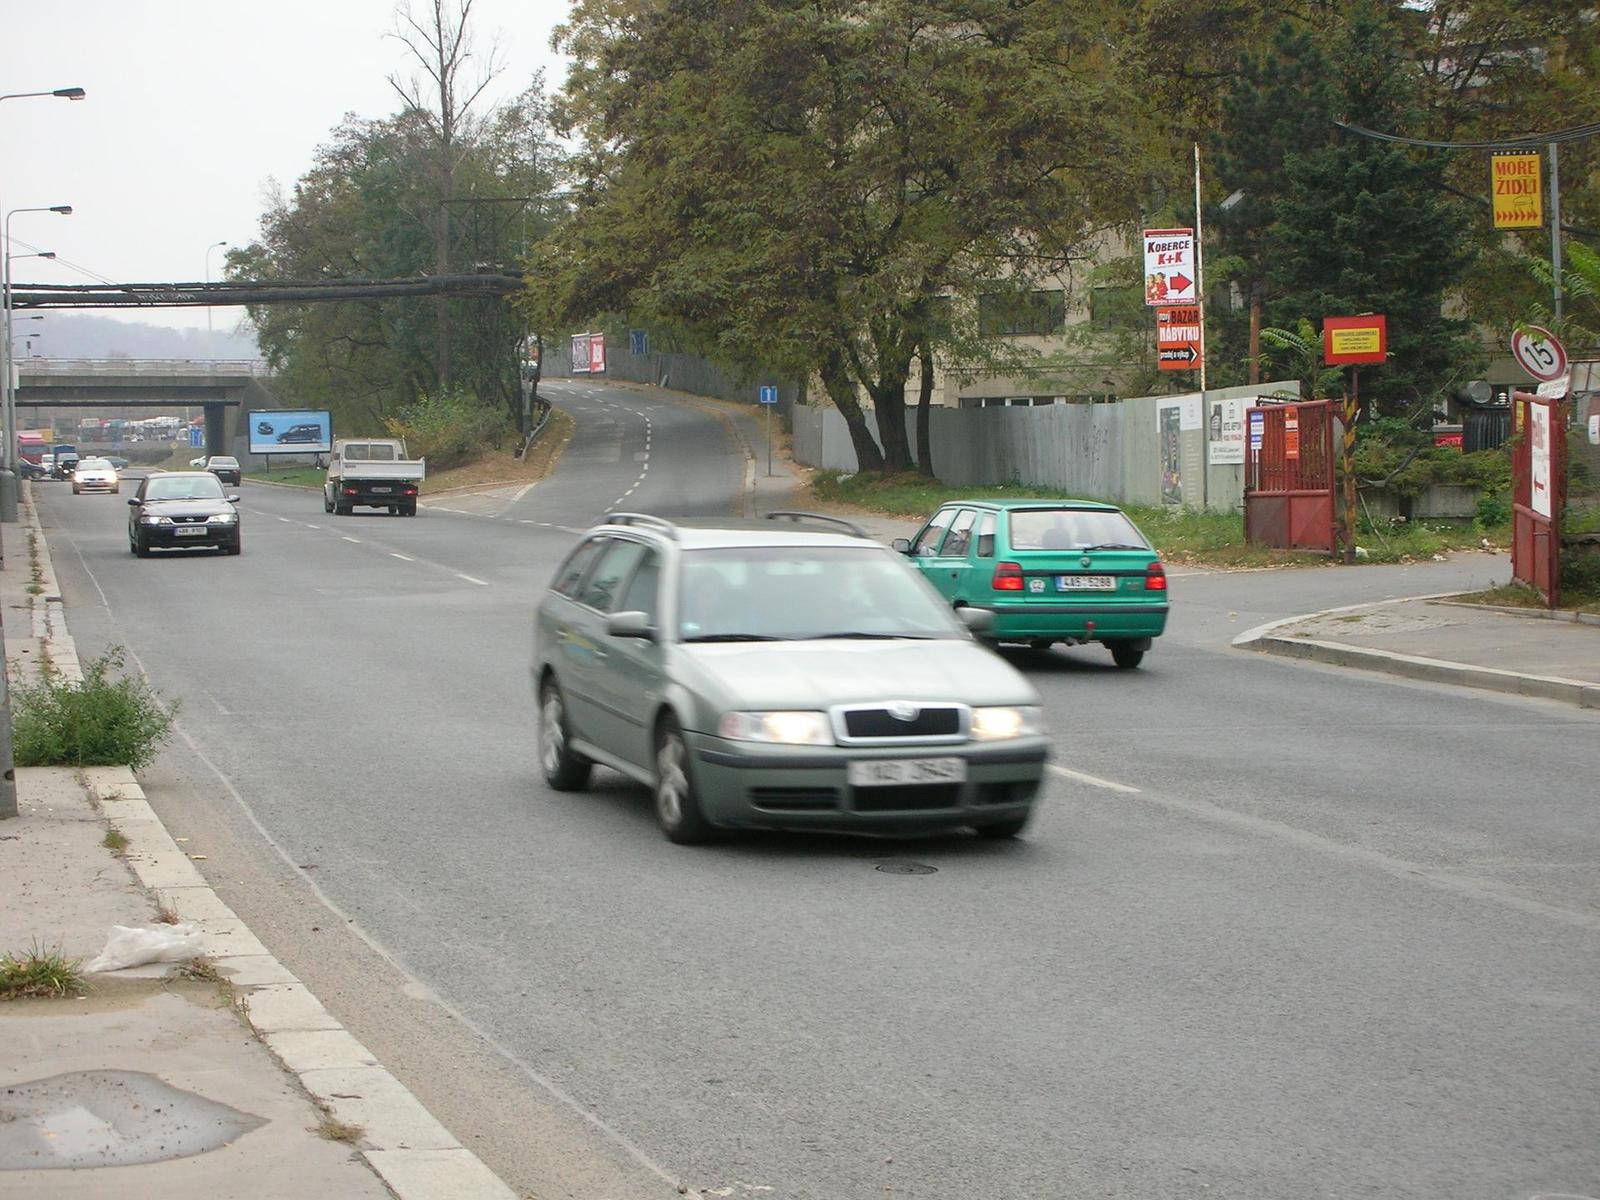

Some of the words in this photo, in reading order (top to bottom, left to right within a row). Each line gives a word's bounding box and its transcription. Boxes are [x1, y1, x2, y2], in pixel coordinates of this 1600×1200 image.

[1496, 176, 1537, 194] ŽIDLÍ
[1158, 251, 1183, 265] K+K
[1170, 310, 1199, 324] BAZAR
[1159, 325, 1200, 342] NÁBYTKU
[1524, 342, 1555, 370] 15
